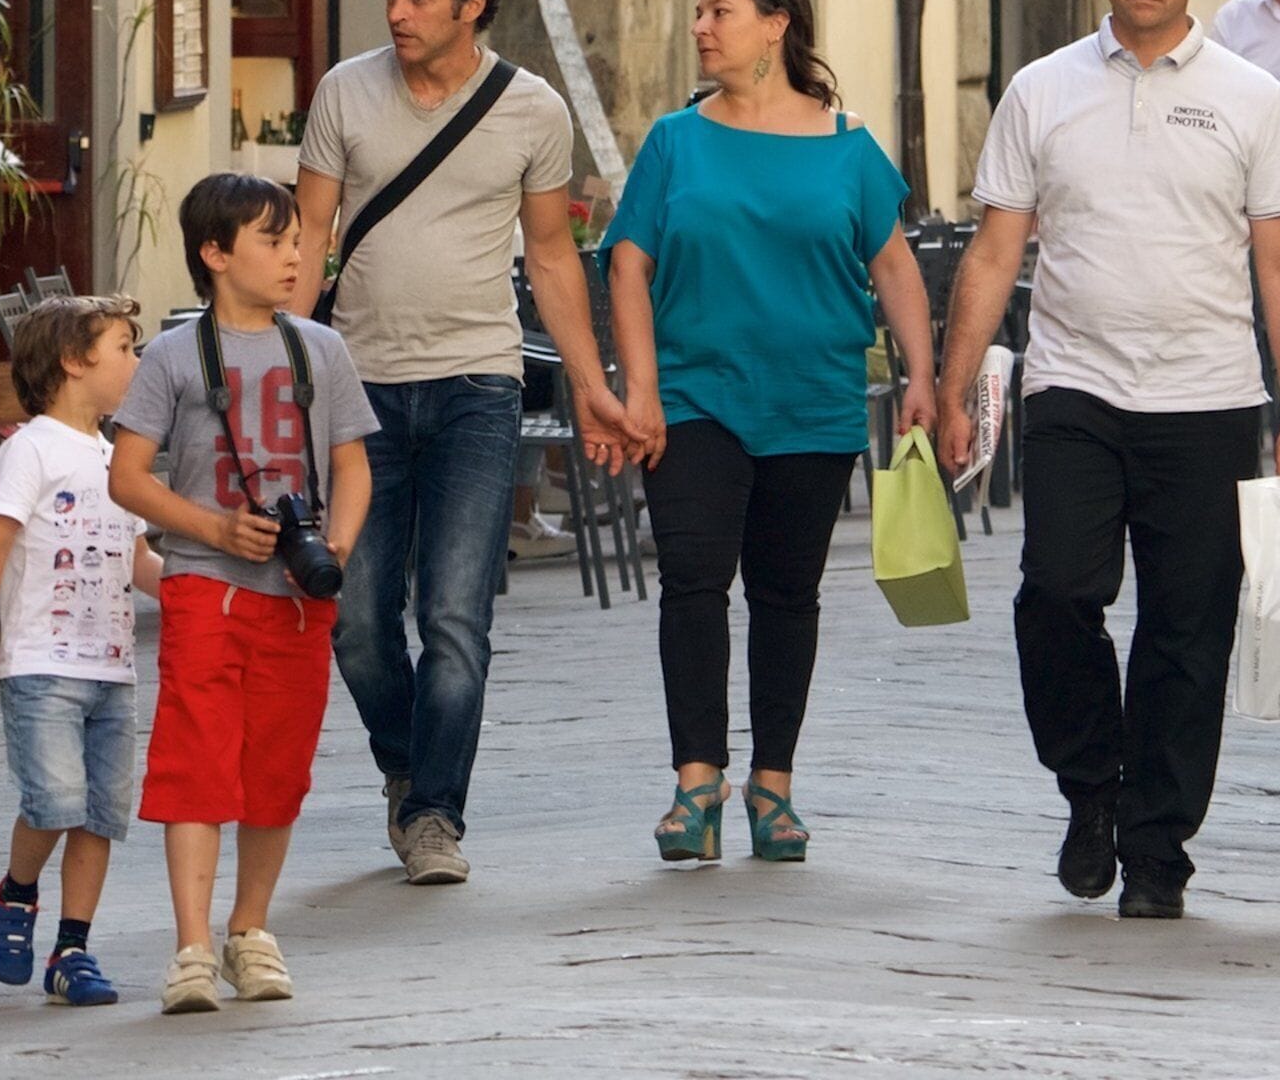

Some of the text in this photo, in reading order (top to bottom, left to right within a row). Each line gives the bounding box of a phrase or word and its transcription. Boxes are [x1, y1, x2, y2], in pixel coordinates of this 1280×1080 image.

[1173, 106, 1215, 119] ENOTECA
[1166, 115, 1218, 132] ENOTRIA
[215, 366, 308, 454] 16
